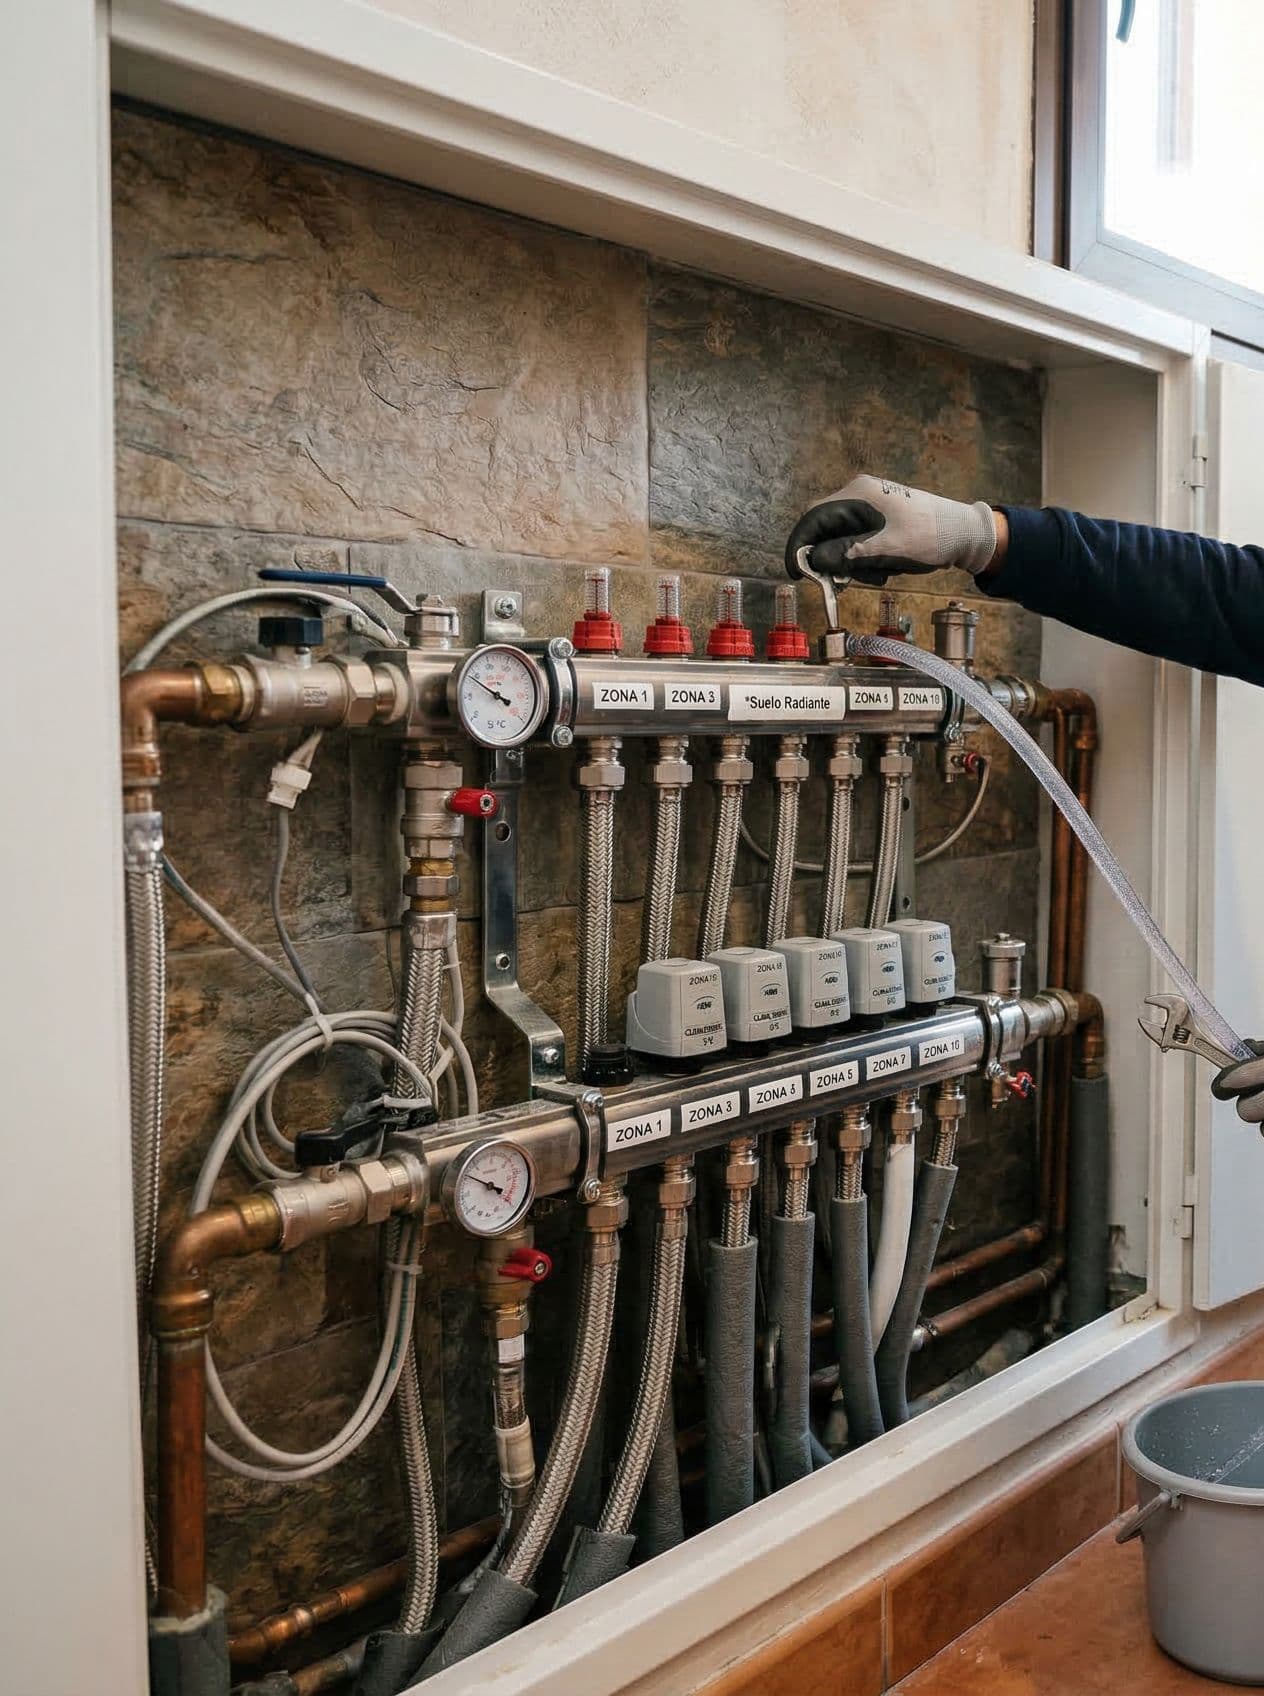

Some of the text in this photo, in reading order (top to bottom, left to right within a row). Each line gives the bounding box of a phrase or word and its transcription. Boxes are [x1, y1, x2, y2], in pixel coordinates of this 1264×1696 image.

[600, 689, 648, 703] ZONA 1
[708, 690, 715, 703] 3
[784, 696, 830, 710] Radiante
[855, 692, 882, 704] ZONA
[903, 693, 929, 705] ZONA
[951, 1039, 960, 1050] 10
[756, 1086, 787, 1104] ZONA
[688, 1100, 733, 1123] ZONA 3
[615, 1119, 662, 1143] ZONA 1
